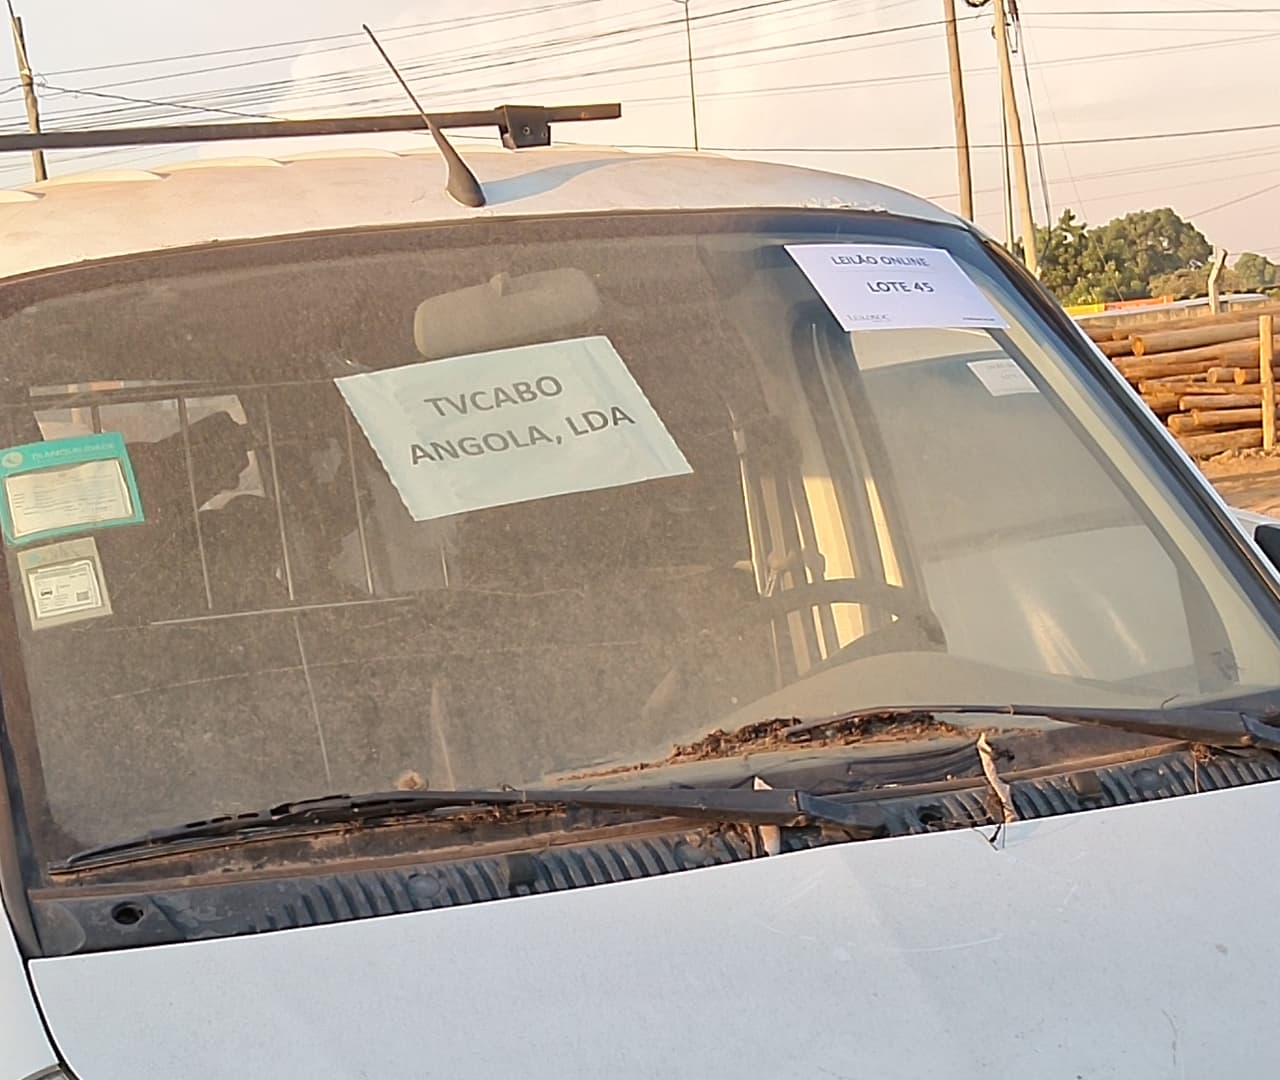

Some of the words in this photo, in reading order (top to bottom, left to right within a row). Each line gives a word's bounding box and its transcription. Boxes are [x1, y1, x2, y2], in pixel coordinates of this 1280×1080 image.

[830, 254, 879, 265] LEILÃO
[880, 256, 930, 267] ONLINE
[866, 281, 912, 293] LOTE
[913, 281, 935, 293] 45
[423, 375, 564, 417] TVCABO
[410, 424, 563, 466] ANGOLA,
[565, 405, 636, 437] LDA
